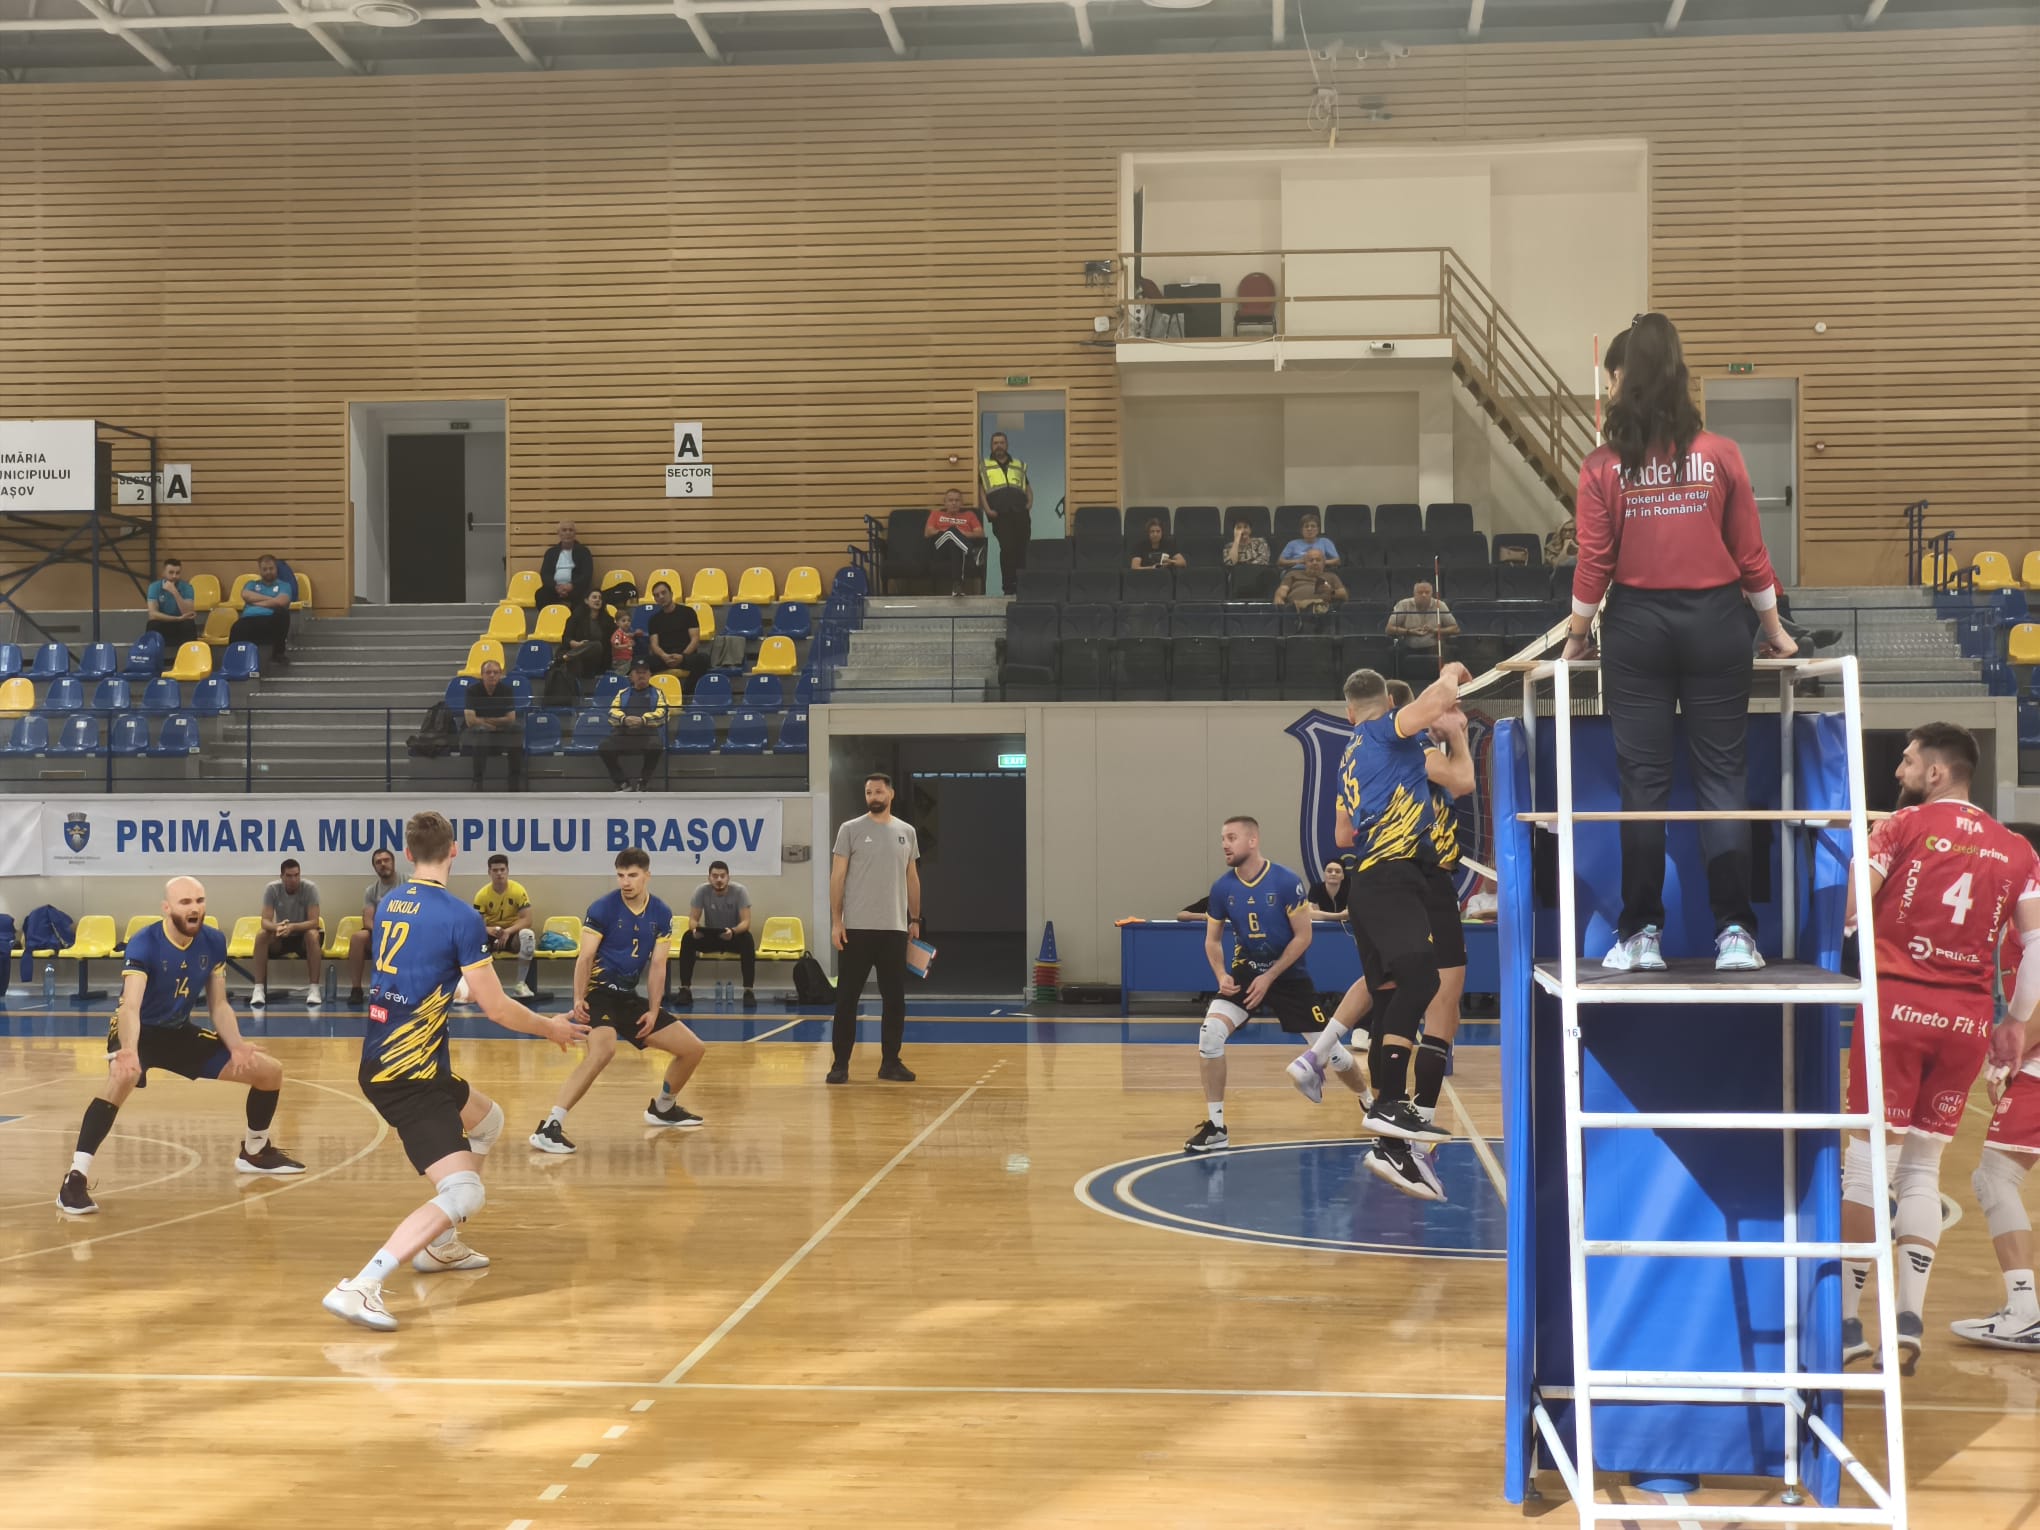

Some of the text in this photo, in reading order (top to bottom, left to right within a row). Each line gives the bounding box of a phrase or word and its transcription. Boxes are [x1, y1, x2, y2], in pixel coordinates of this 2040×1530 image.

[677, 433, 700, 458] A
[0, 469, 71, 480] NICIPIULUI
[667, 468, 712, 478] SECTOR
[136, 488, 145, 501] 2
[166, 474, 189, 499] A
[685, 481, 694, 494] 3
[1668, 492, 1682, 502] de
[117, 811, 764, 865] PRIMĂRIA MUNPIULUI BRAȘOV
[386, 899, 421, 914] NIKULA
[1941, 872, 1974, 926] 4
[1248, 912, 1260, 932] 6
[375, 920, 410, 975] 12
[630, 938, 639, 958] 2
[173, 976, 190, 999] 14
[1311, 1005, 1326, 1023] 6
[1890, 1004, 1949, 1029] Kineto
[1952, 1016, 1975, 1034] Fit
